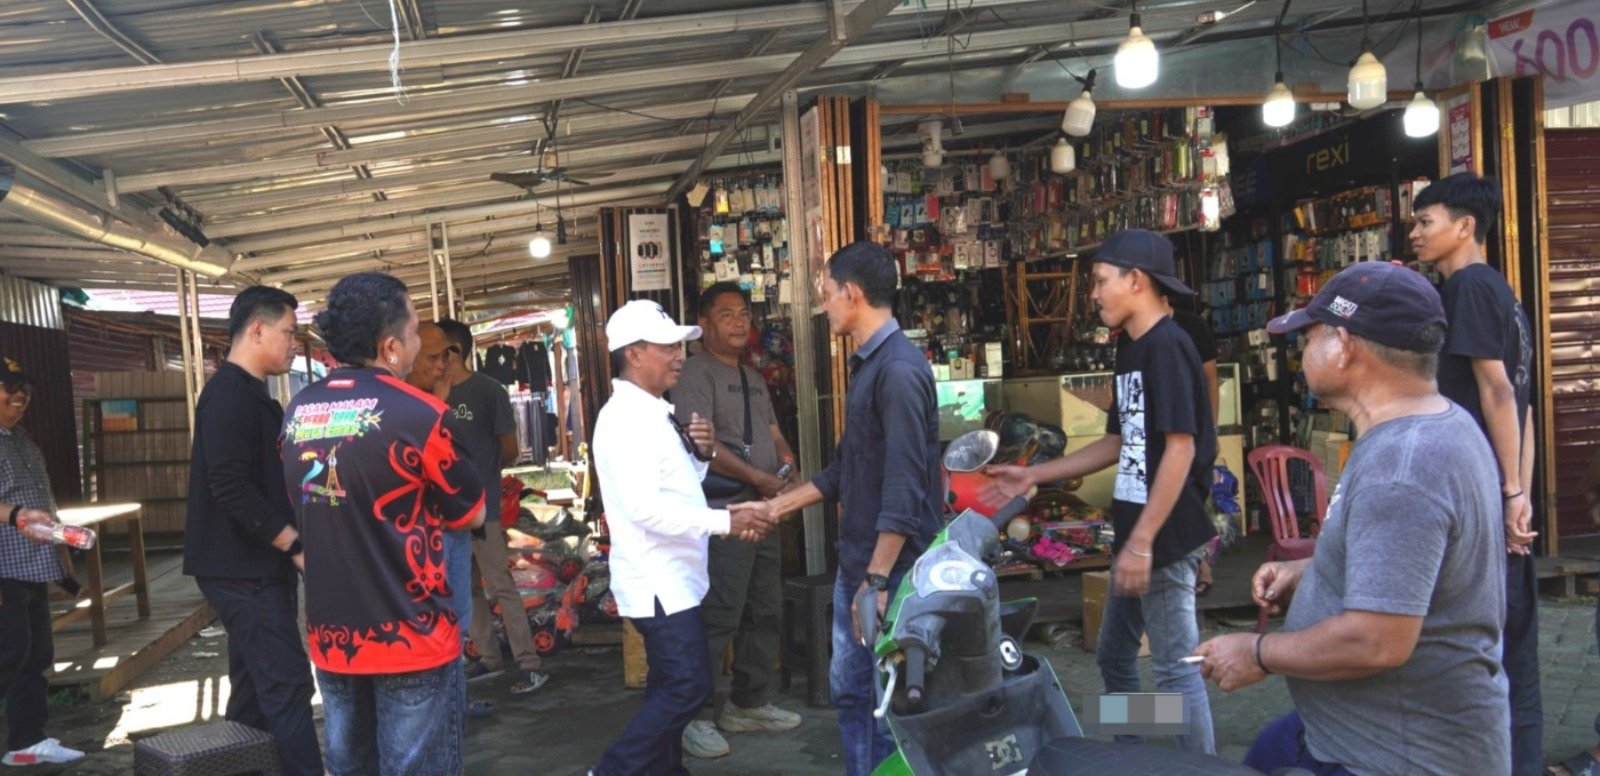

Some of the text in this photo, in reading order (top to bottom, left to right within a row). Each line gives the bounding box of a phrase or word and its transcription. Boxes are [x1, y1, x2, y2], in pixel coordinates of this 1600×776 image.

[1498, 18, 1520, 31] NEW
[1306, 135, 1350, 174] rexi
[295, 398, 378, 417] PASAR MALAM
